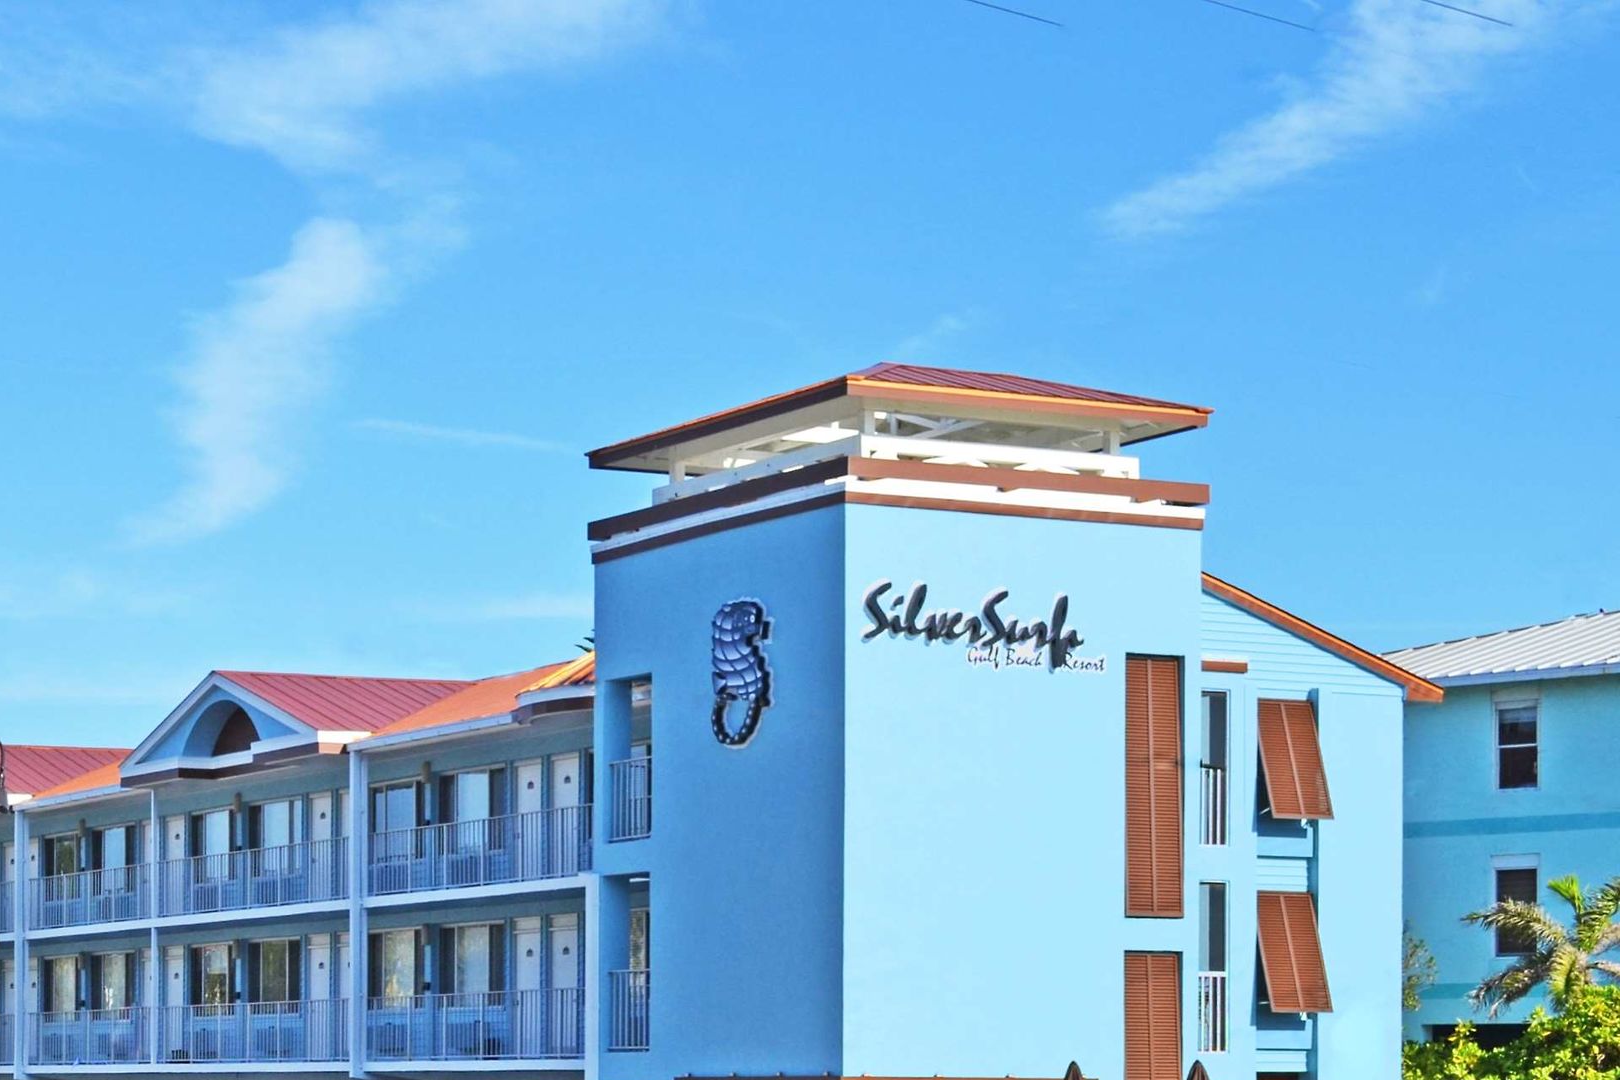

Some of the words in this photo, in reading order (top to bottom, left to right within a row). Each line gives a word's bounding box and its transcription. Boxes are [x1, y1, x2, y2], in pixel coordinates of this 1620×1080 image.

[967, 647, 999, 669] Gulf
[1005, 648, 1042, 667] Beach
[1062, 652, 1105, 671] Resort
